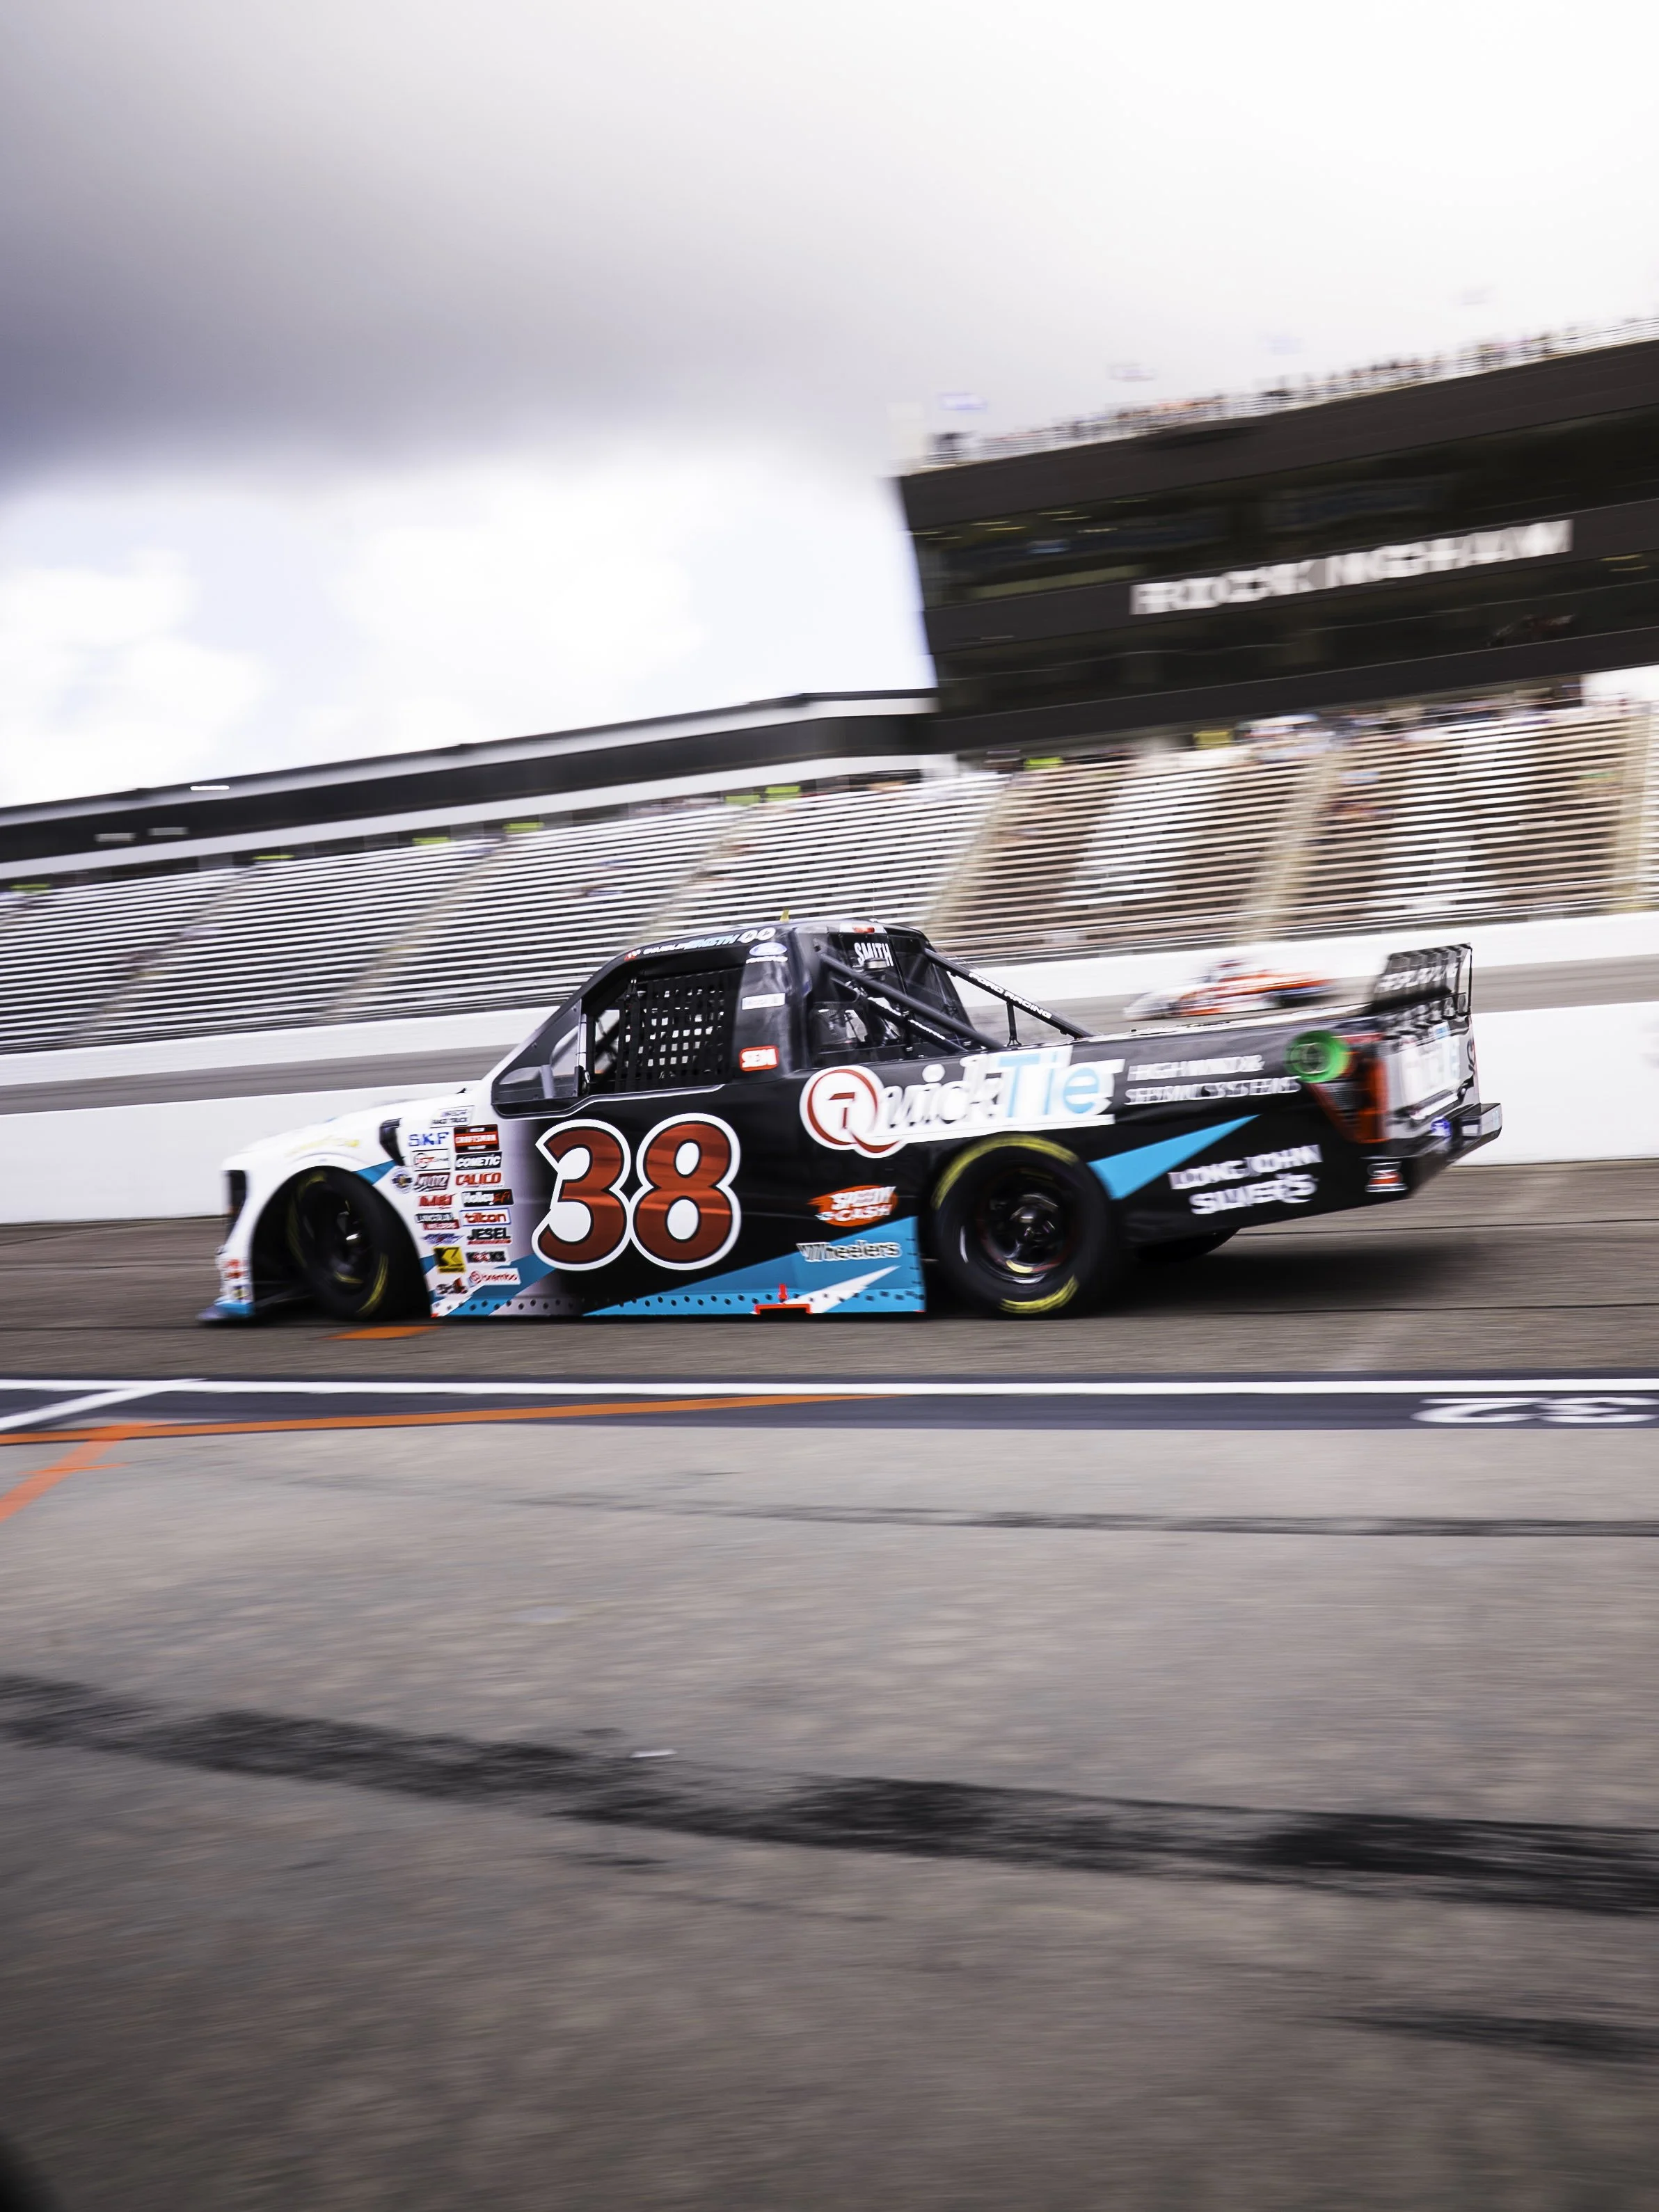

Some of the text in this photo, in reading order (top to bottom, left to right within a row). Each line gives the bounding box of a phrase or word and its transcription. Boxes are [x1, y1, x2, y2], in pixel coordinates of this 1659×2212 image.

[1129, 519, 1573, 615] ROCKINGHAM
[854, 942, 894, 969] SMITH
[968, 971, 1053, 1019] FORD RACING
[741, 1049, 777, 1068] SEM
[800, 1045, 1125, 1158] QuickTie
[408, 1132, 449, 1147] SKF
[456, 1154, 501, 1168] COMETIC
[456, 1172, 502, 1186] CALICO
[1168, 1160, 1247, 1190] LONG
[532, 1113, 741, 1271] 38
[464, 1212, 507, 1223] tilton
[835, 1204, 892, 1222] CASH
[467, 1227, 511, 1240] JESEL
[796, 1240, 903, 1262] Wheelers
